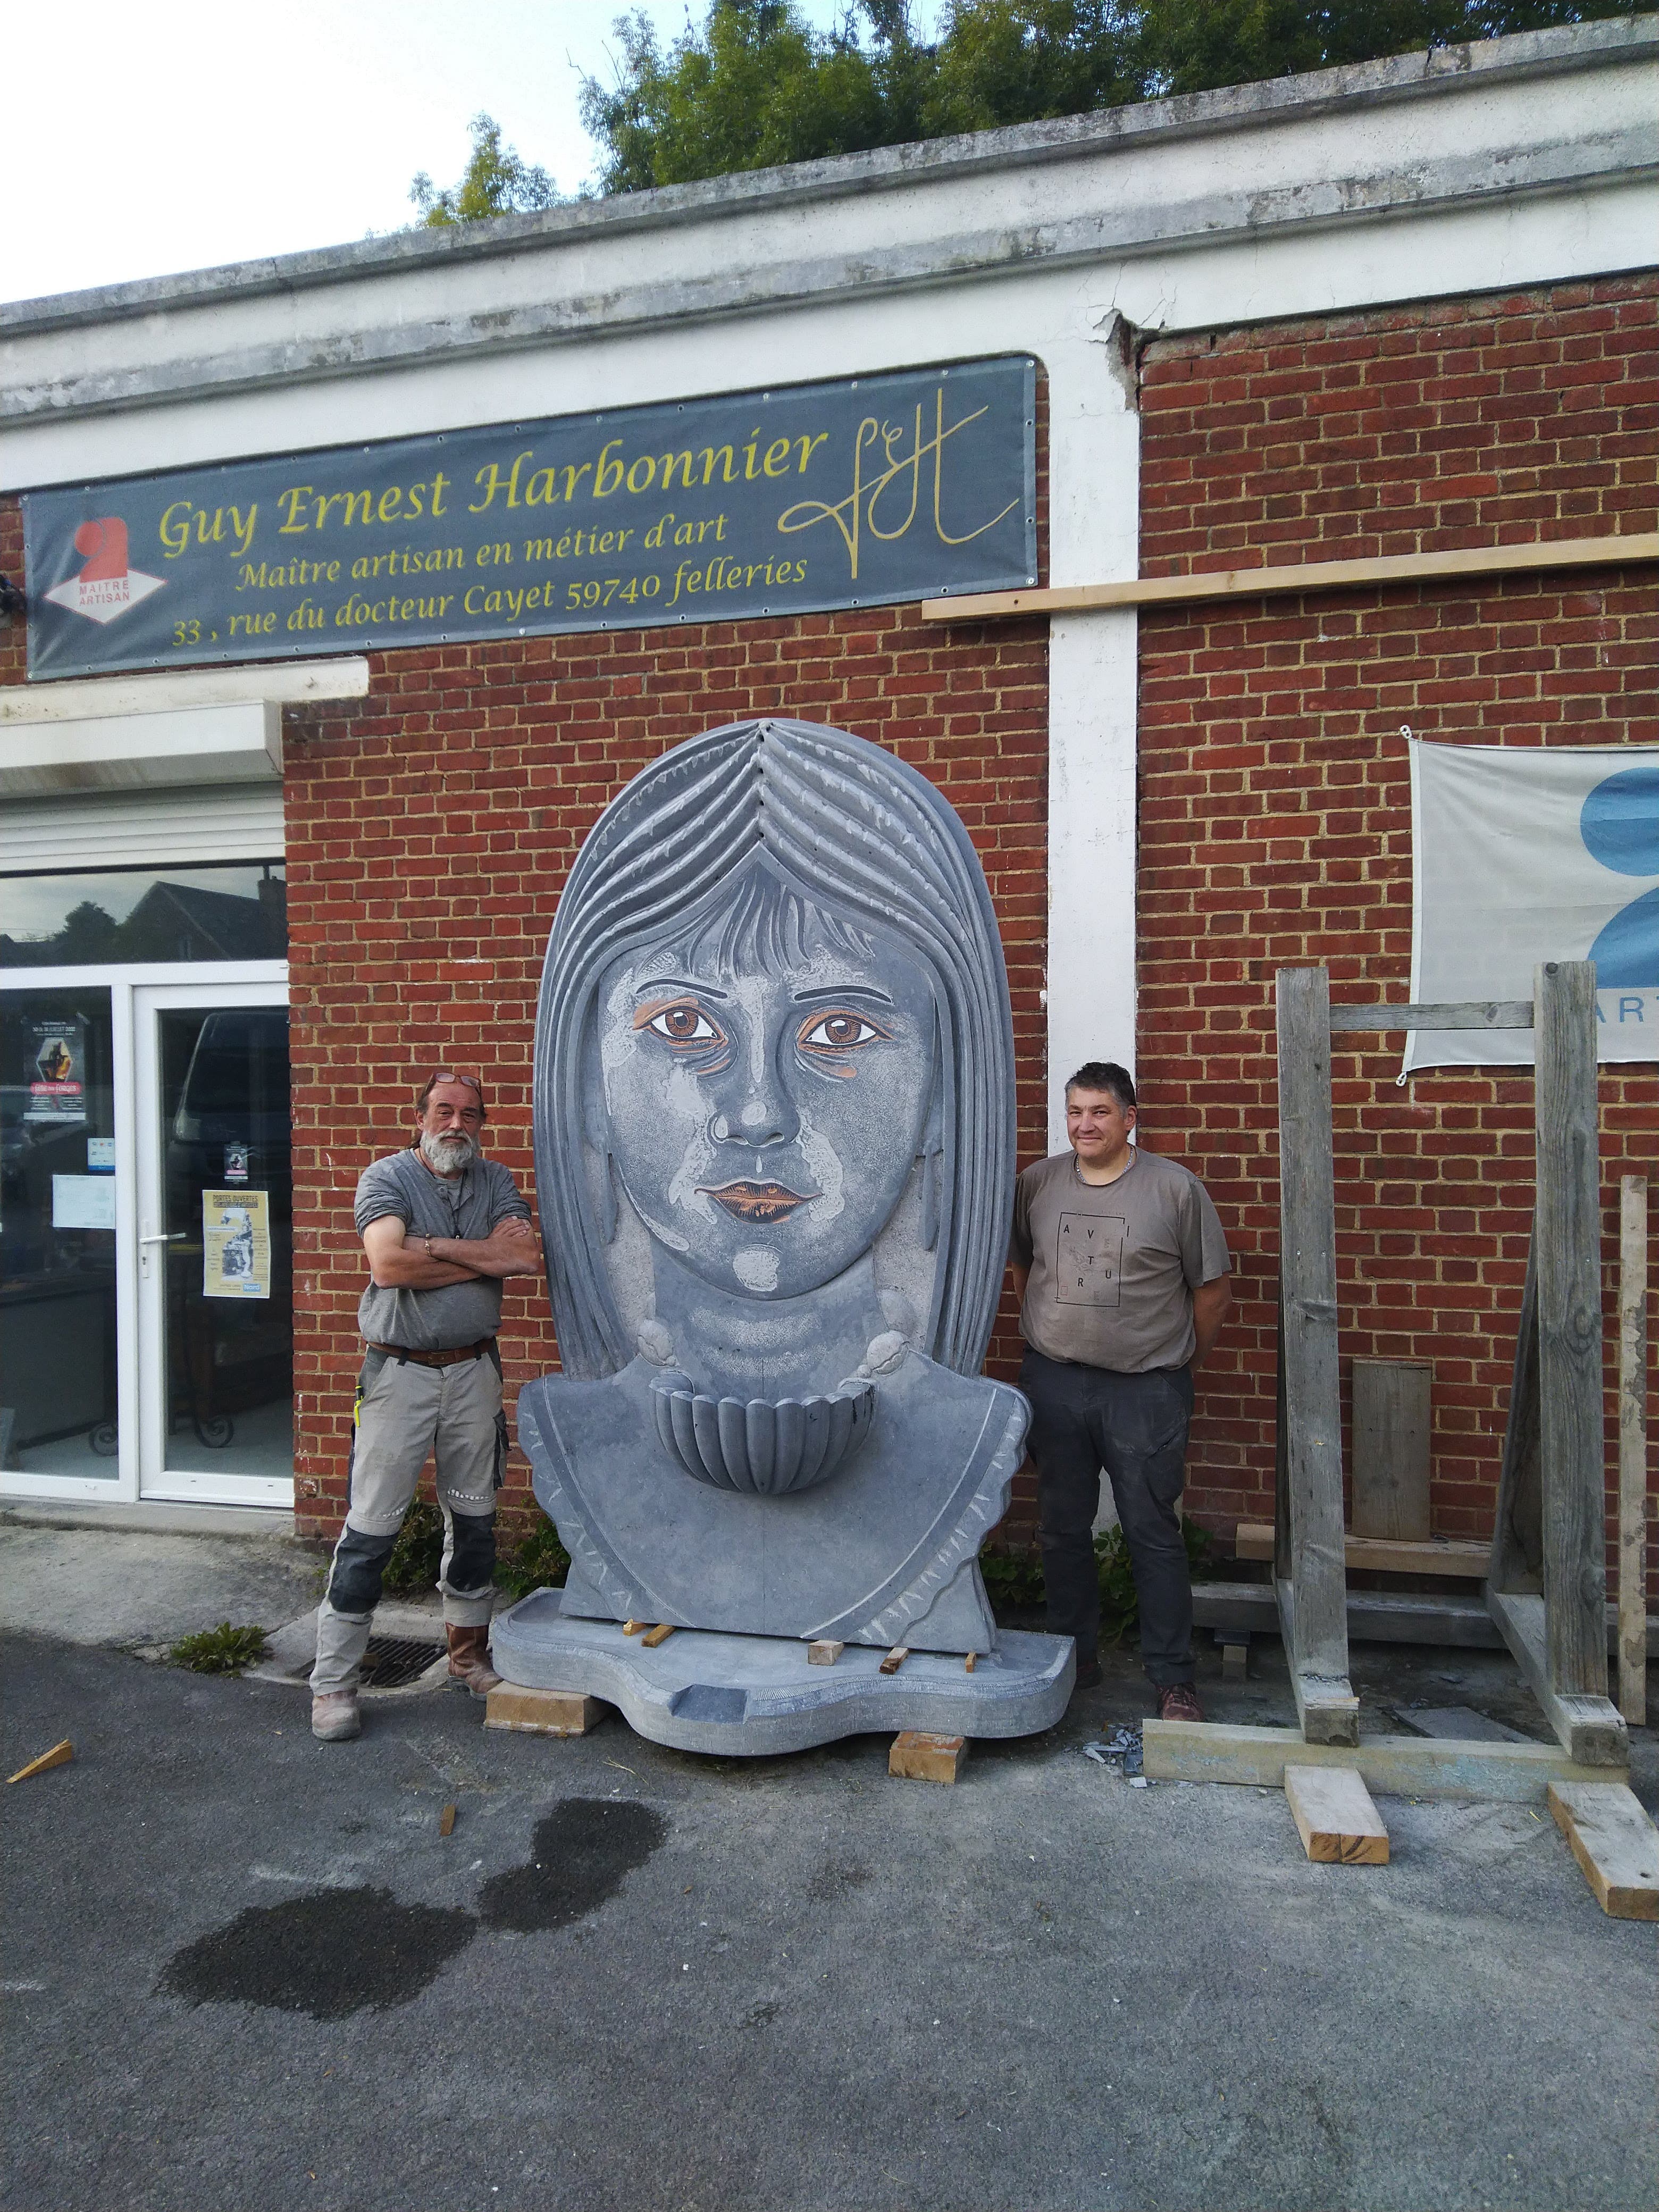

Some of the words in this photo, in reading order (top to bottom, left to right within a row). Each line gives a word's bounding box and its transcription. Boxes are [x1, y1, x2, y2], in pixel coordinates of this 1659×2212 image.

[160, 501, 257, 558] Guy
[278, 472, 450, 533] Ernest
[468, 426, 828, 513] Harbonnier
[235, 557, 341, 591] Maître
[352, 546, 465, 579] artisan
[476, 541, 512, 566] en
[525, 525, 635, 562] métier
[643, 513, 728, 549] d'art
[79, 591, 130, 606] ARTISAN
[172, 619, 201, 646] 33
[229, 611, 276, 636] rue
[287, 597, 325, 631] du
[335, 593, 455, 627] docteur
[464, 580, 555, 622] Cayet
[565, 575, 660, 610] 59740
[665, 555, 808, 607] felleries
